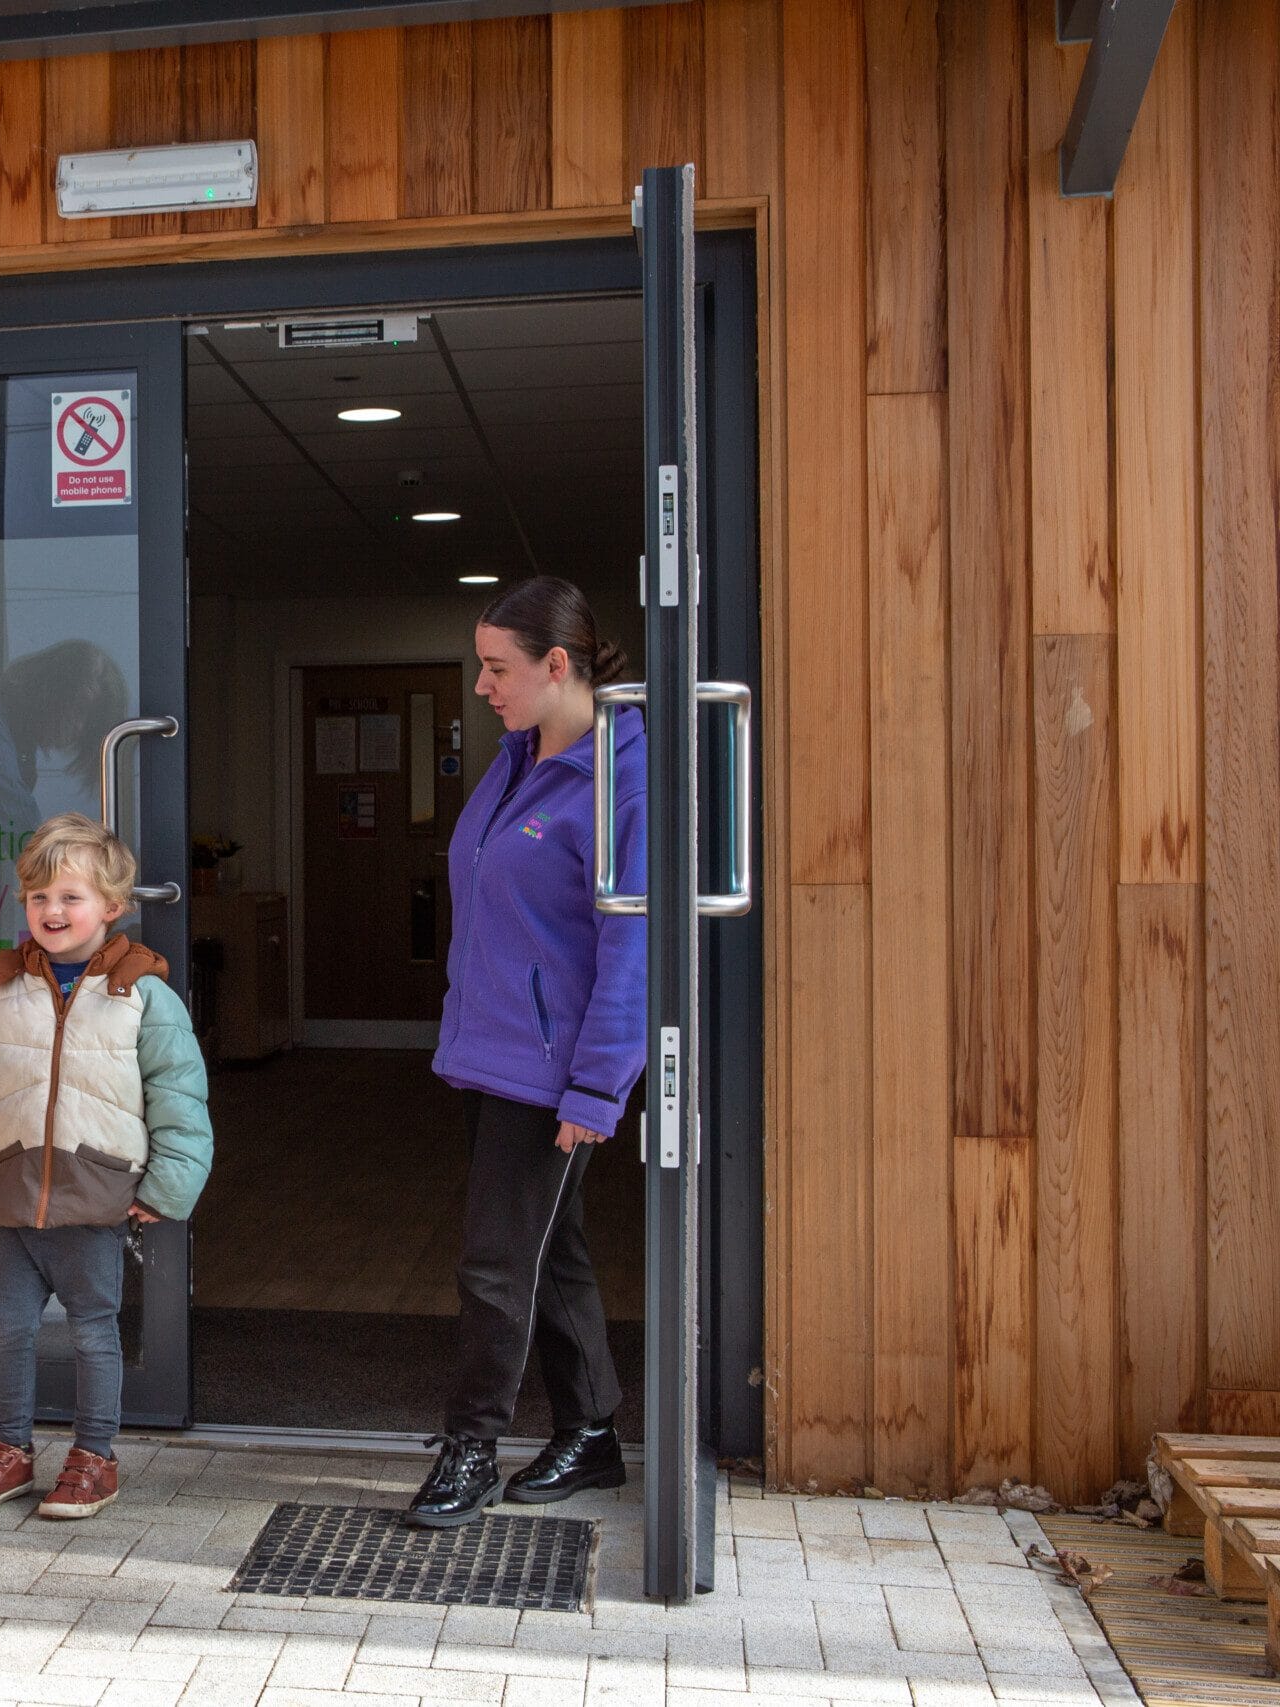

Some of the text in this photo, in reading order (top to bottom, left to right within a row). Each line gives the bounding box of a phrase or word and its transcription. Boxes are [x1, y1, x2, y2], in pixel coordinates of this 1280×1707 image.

[69, 476, 81, 484] Do
[82, 476, 97, 484] not
[60, 486, 123, 496] mobile phones
